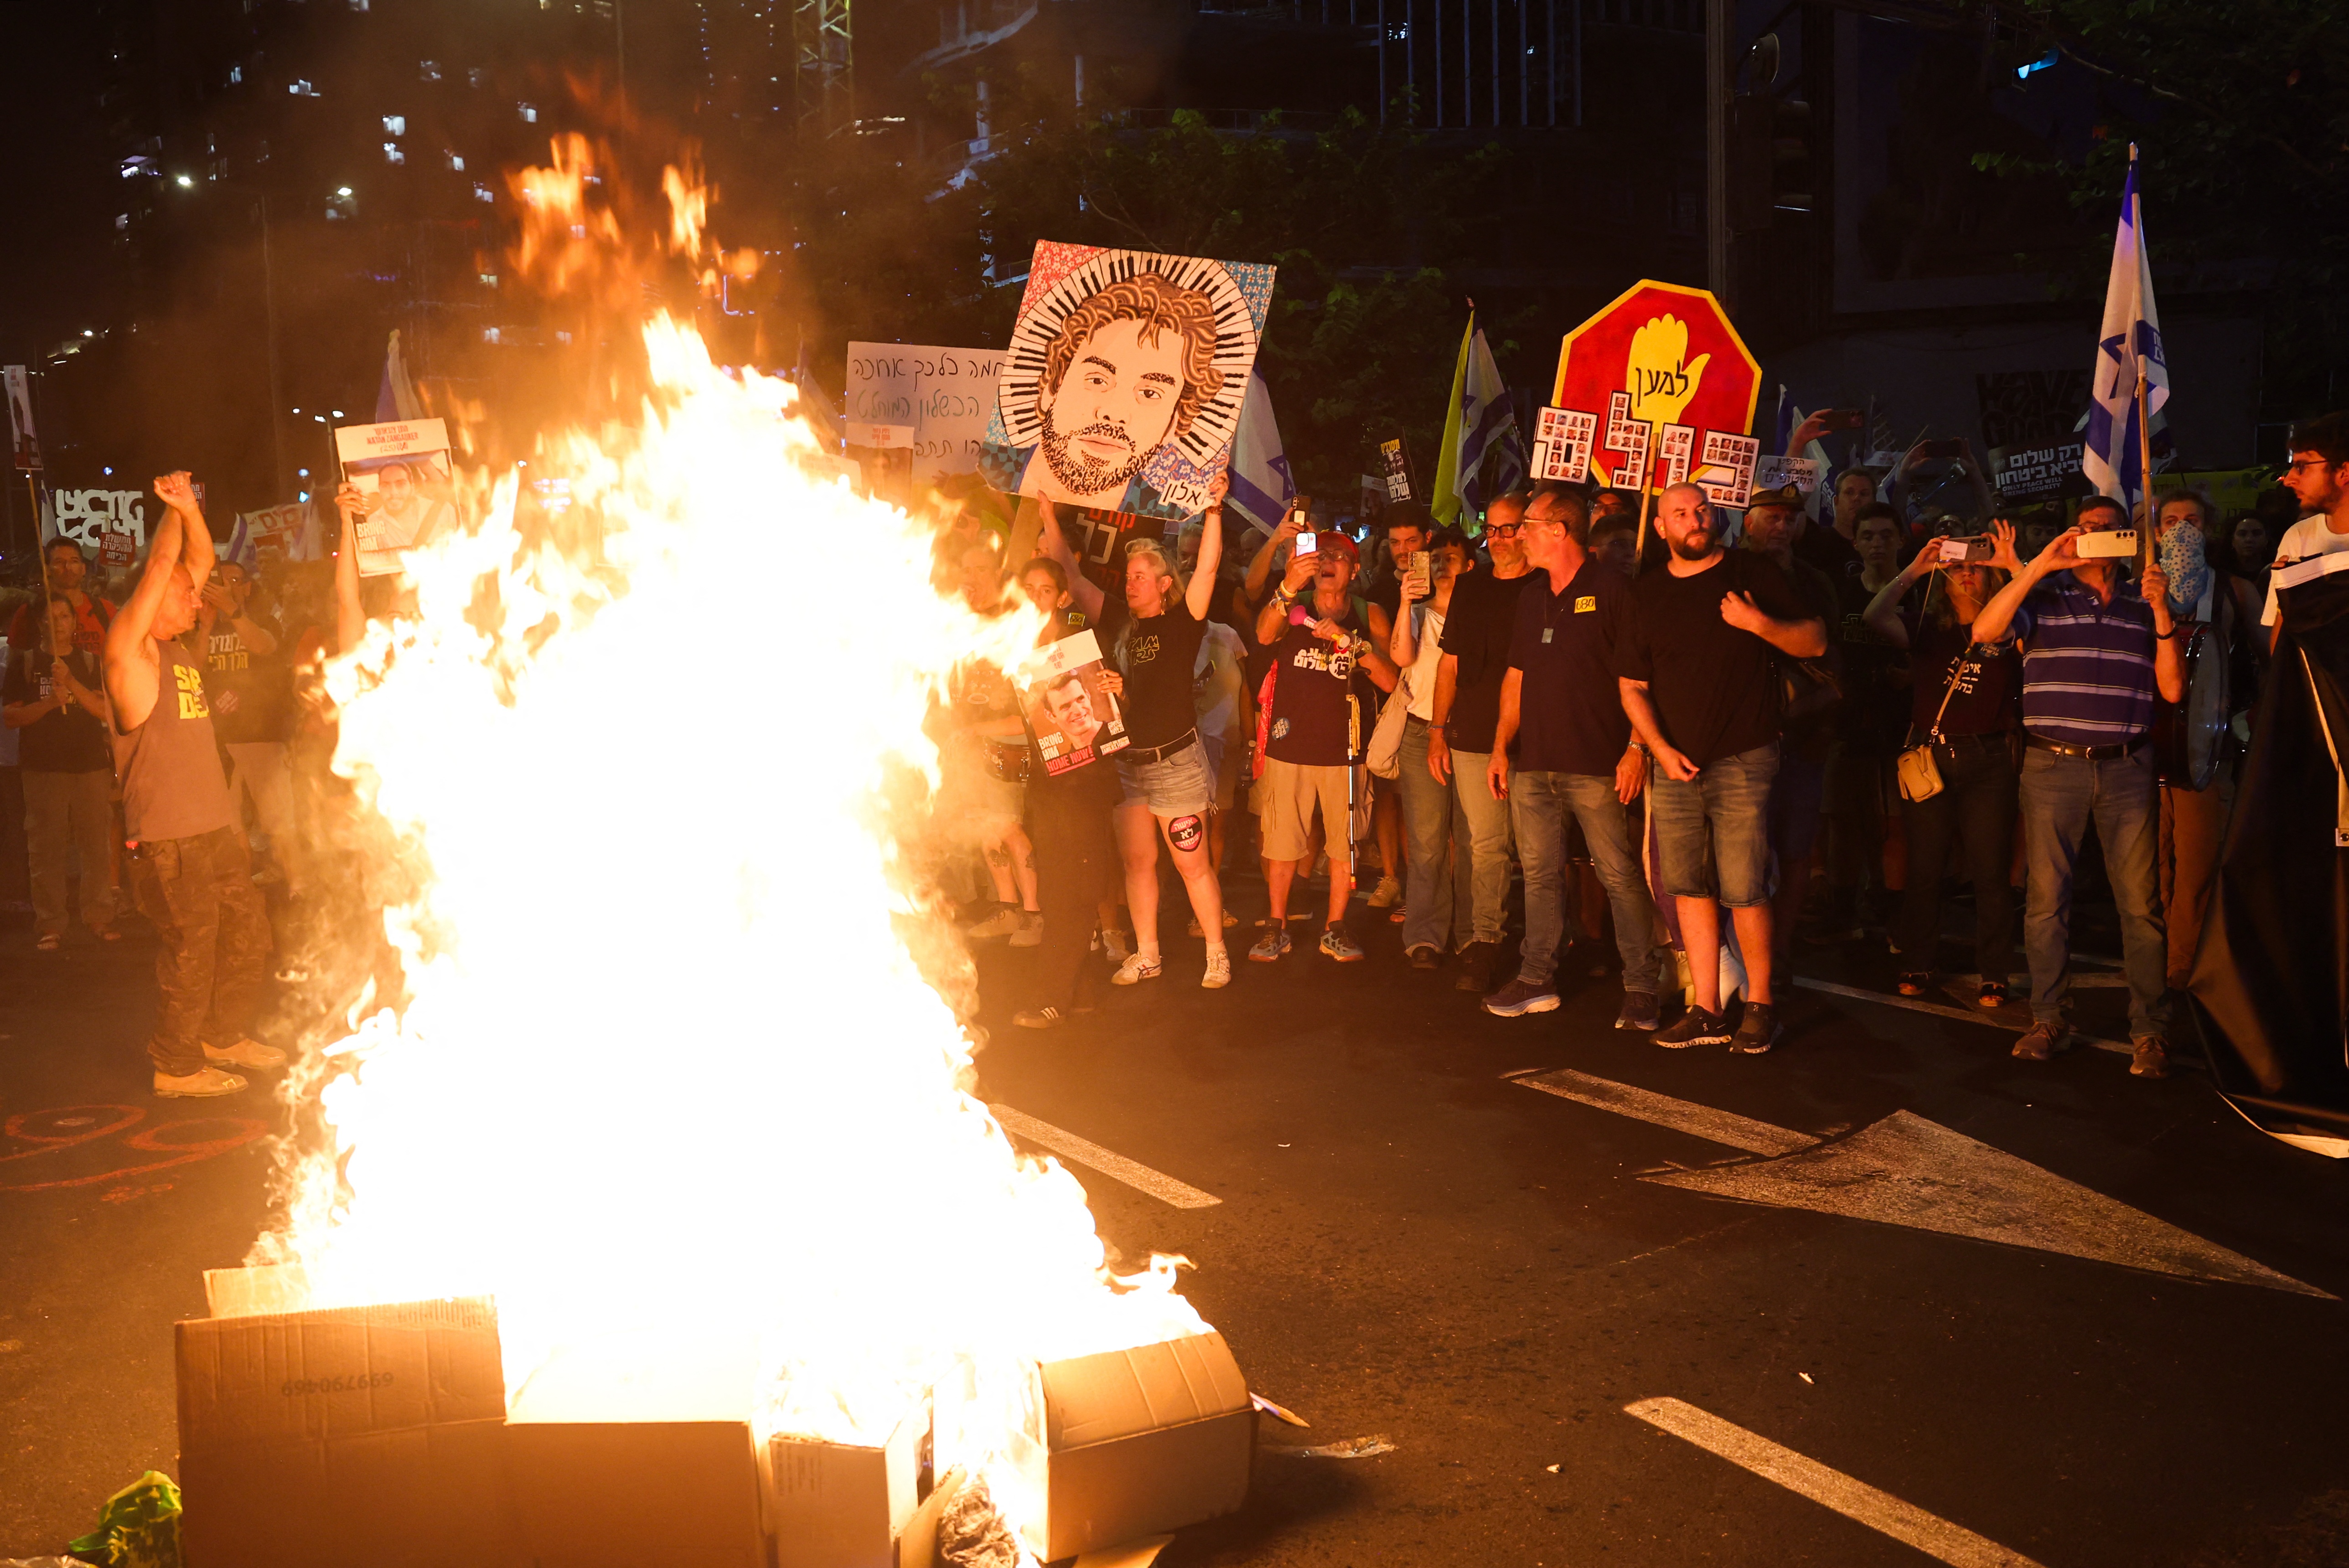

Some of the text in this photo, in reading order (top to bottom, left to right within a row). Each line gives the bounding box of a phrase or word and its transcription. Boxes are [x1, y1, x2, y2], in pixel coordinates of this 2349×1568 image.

[1635, 359, 1690, 407] למען
[919, 389, 979, 432] הכשלון
[2009, 448, 2055, 469] שלום
[2058, 444, 2082, 462] רק
[1995, 458, 2083, 489] יביא ביטחון
[2002, 476, 2063, 492] ONLY PEACE WILL
[2027, 482, 2061, 493] SECURITY
[1163, 481, 1201, 506] אלון
[356, 521, 386, 538] BRING
[358, 536, 379, 551] HIM
[1576, 598, 1594, 610] 680
[1293, 655, 1328, 671] שלום
[1038, 731, 1064, 750] BRING
[1041, 745, 1060, 762] HIM
[1045, 745, 1094, 772] HOME NOW!
[1174, 817, 1194, 830] אישה
[1180, 827, 1194, 840] לא
[1180, 833, 1199, 848] שפחה
